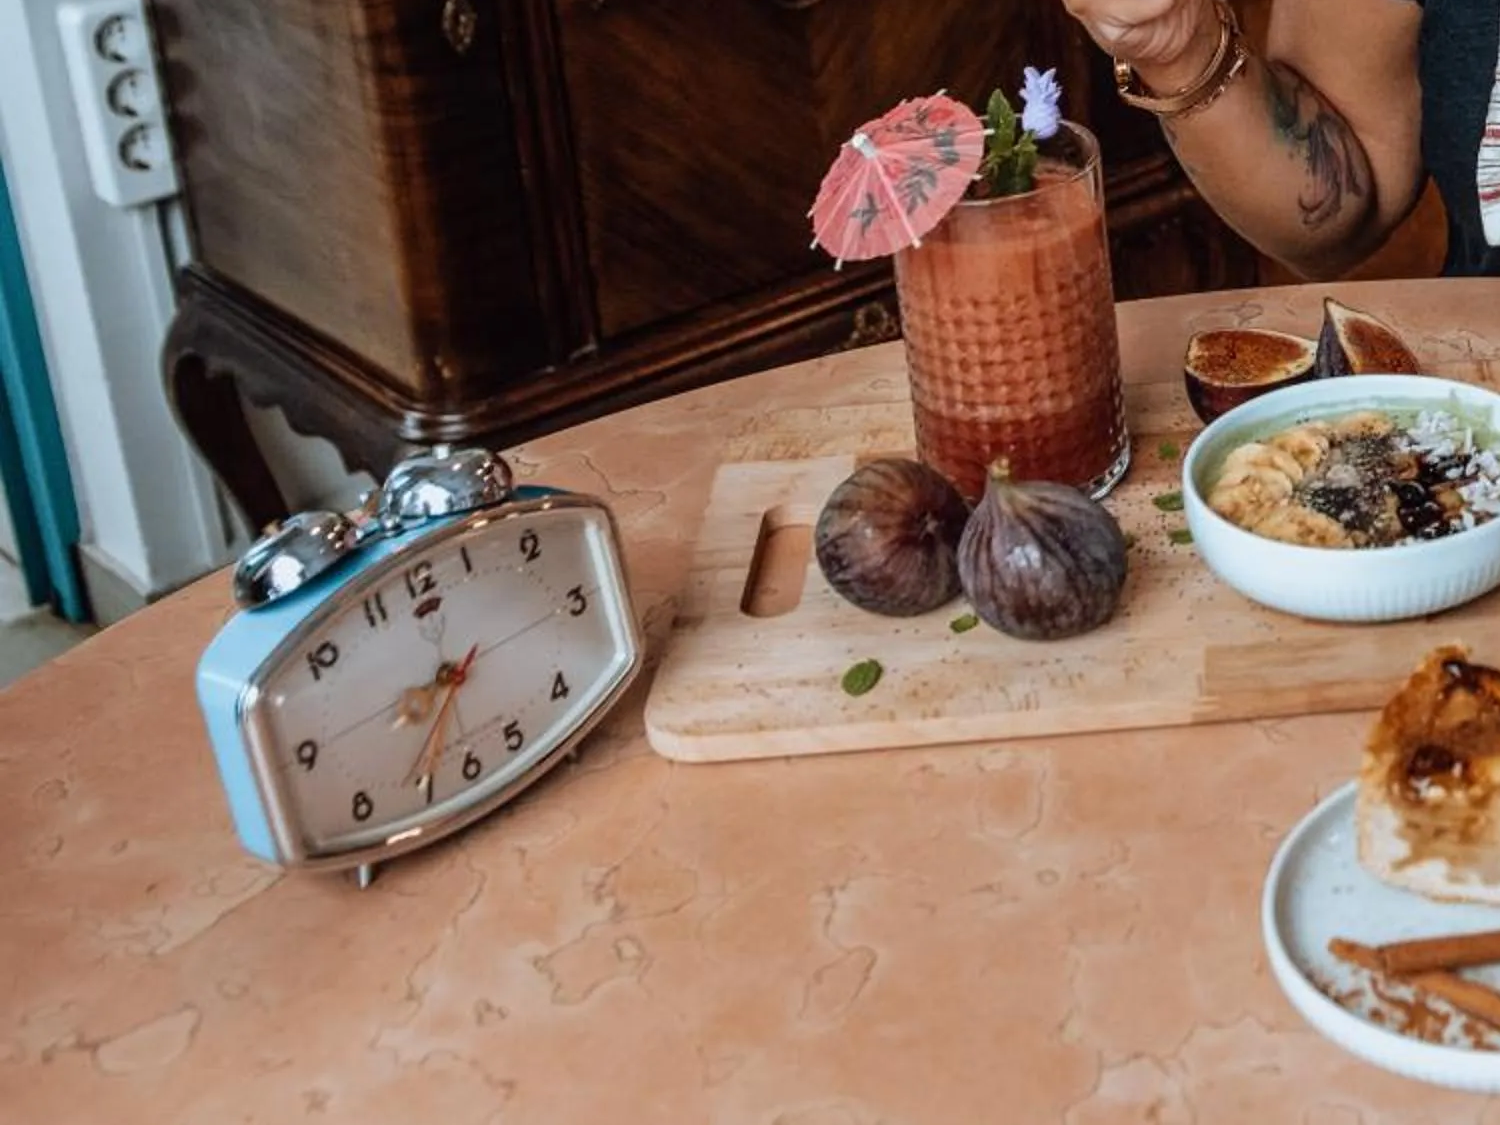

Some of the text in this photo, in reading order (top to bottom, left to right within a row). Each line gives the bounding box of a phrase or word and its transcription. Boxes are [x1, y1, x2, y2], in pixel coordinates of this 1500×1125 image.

[459, 547, 472, 572] 1
[519, 529, 541, 561] 2
[404, 562, 438, 598] 12
[363, 593, 388, 628] 11
[566, 587, 587, 616] 3
[307, 642, 340, 681] 10
[549, 672, 570, 701] 4
[503, 721, 524, 752] 5
[297, 740, 318, 771] 9
[462, 752, 481, 779] 6
[352, 791, 374, 821] 8
